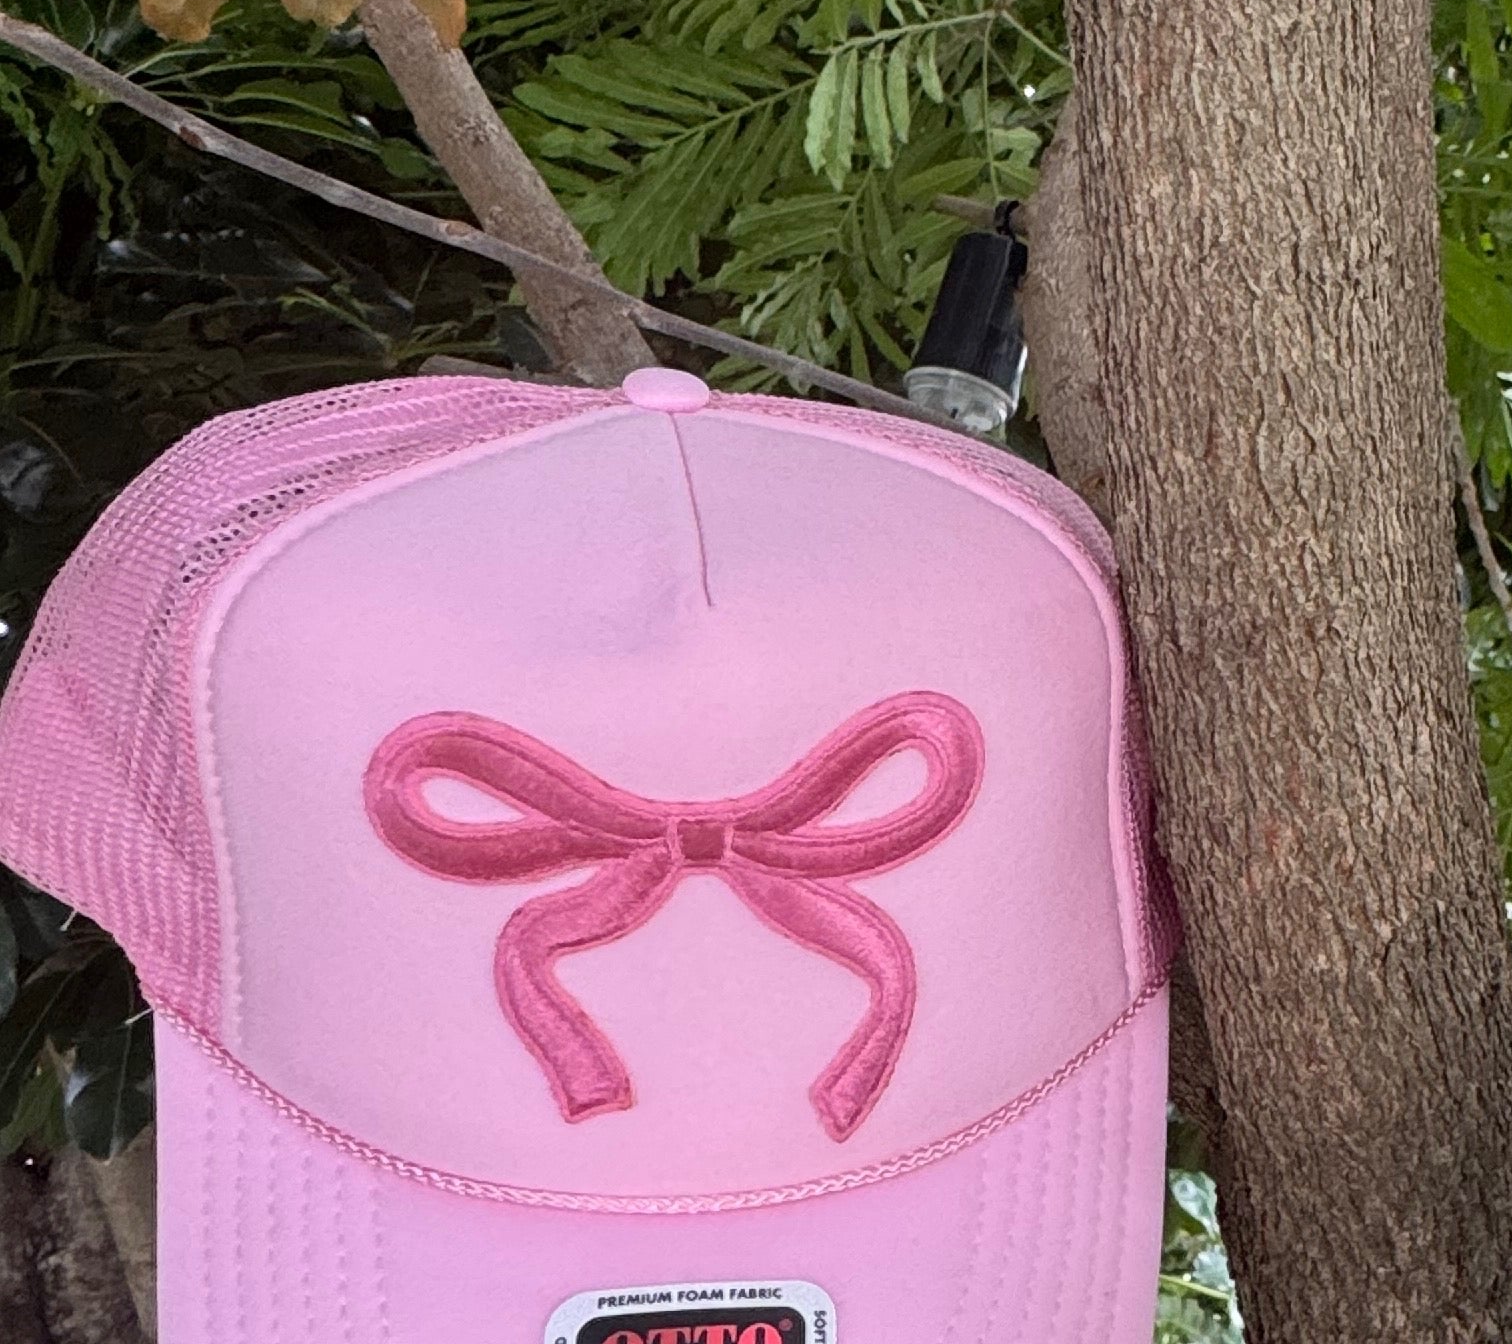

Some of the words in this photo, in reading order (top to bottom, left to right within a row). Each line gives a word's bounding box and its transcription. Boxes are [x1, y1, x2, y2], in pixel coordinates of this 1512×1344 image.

[598, 1291, 672, 1309] PREMIUM
[677, 1288, 723, 1303] FOAM
[729, 1287, 782, 1301] FABRIC
[814, 1309, 827, 1344] SOFT
